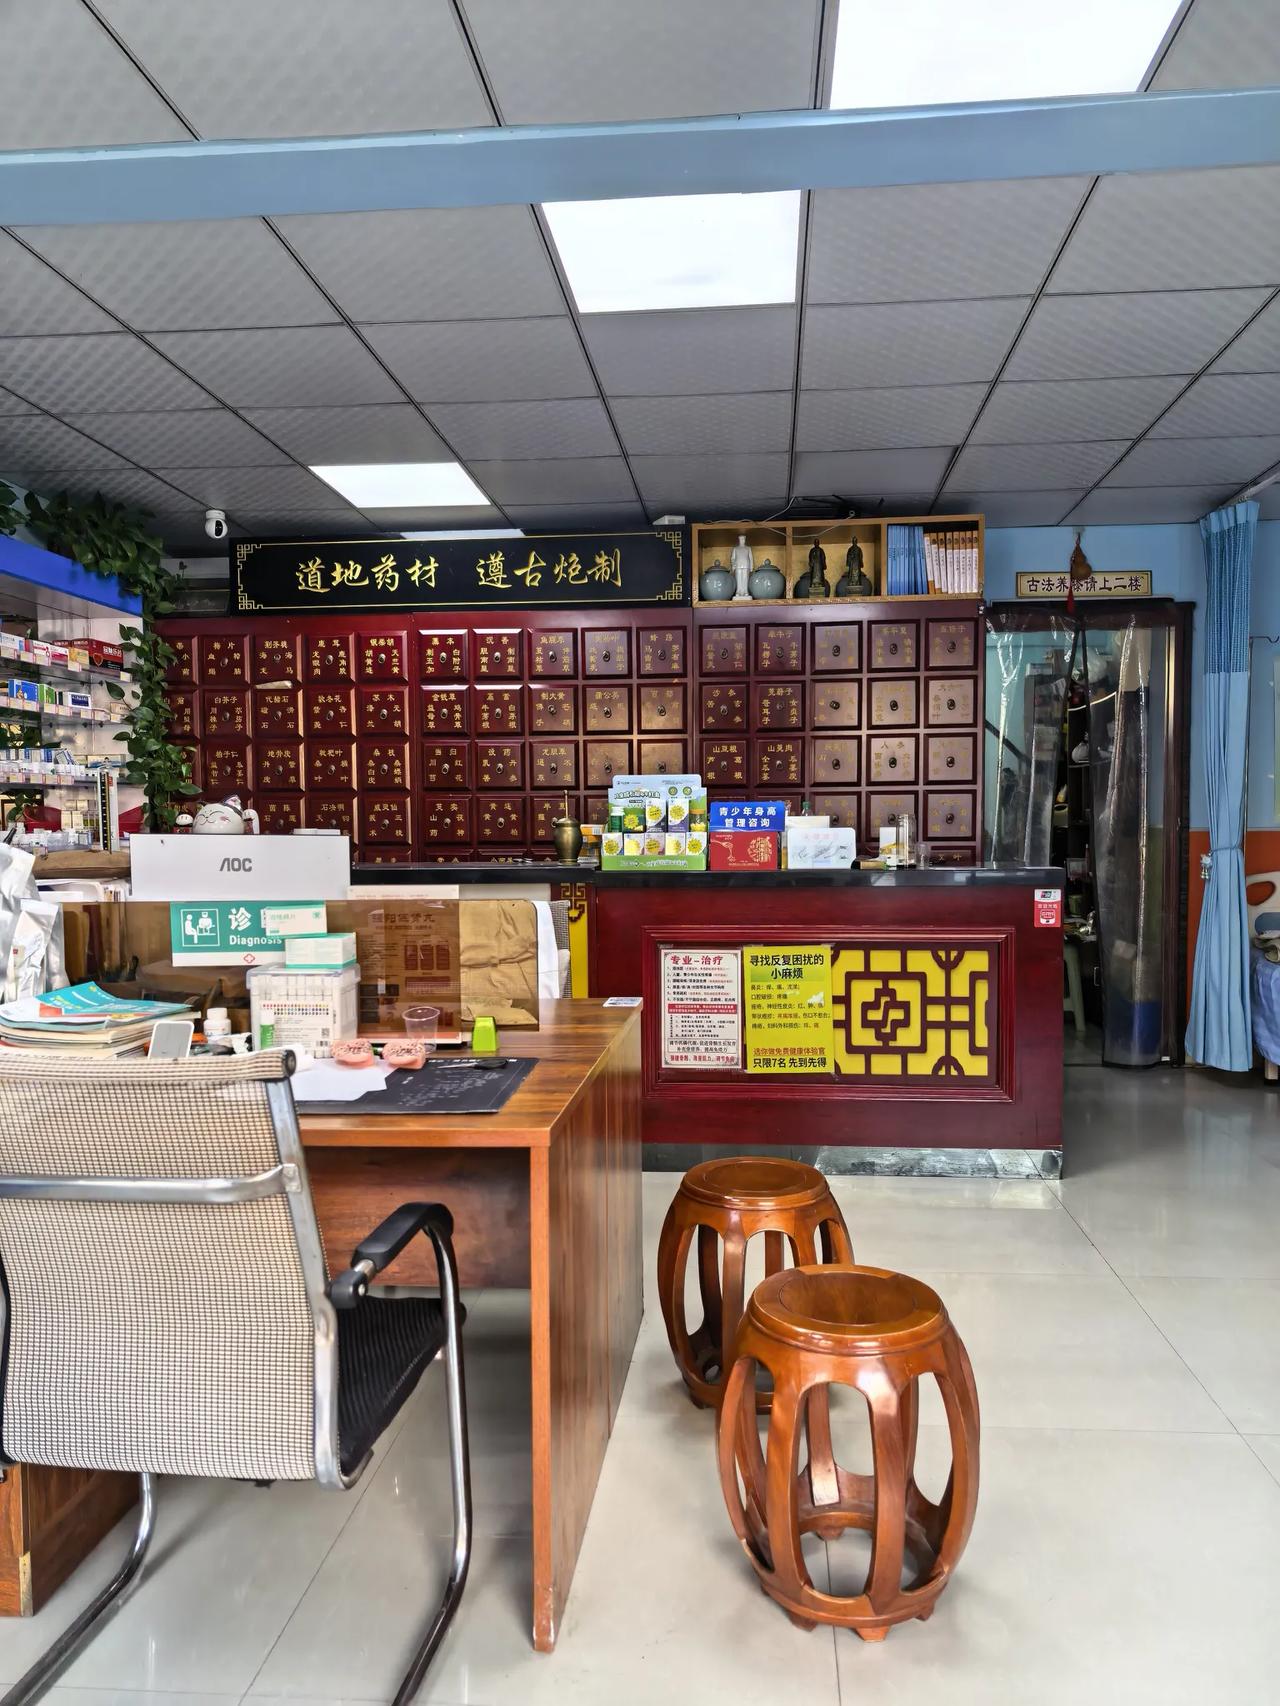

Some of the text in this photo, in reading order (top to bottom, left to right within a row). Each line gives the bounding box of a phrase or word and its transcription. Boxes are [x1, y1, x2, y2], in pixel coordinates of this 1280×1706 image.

[296, 548, 623, 593] 道地药材 遵古炮制
[426, 648, 434, 673] 刺五加
[453, 649, 461, 673] 白附子
[432, 693, 456, 701] 金钱草
[427, 704, 435, 728] 益母草
[789, 699, 798, 724] 女贞子
[373, 748, 395, 756] 桑枝
[713, 745, 737, 753] 山豆根
[455, 760, 463, 781] 红花
[720, 807, 776, 816] 青少年身高
[429, 814, 438, 837] 山药
[725, 818, 770, 827] 管理咨询
[219, 858, 252, 872] AOC
[229, 935, 282, 947] Diagnosis
[750, 955, 824, 966] 寻找反复困扰的
[771, 968, 803, 979] 小麻烦
[753, 1057, 826, 1068] 只限7名 先到先得
